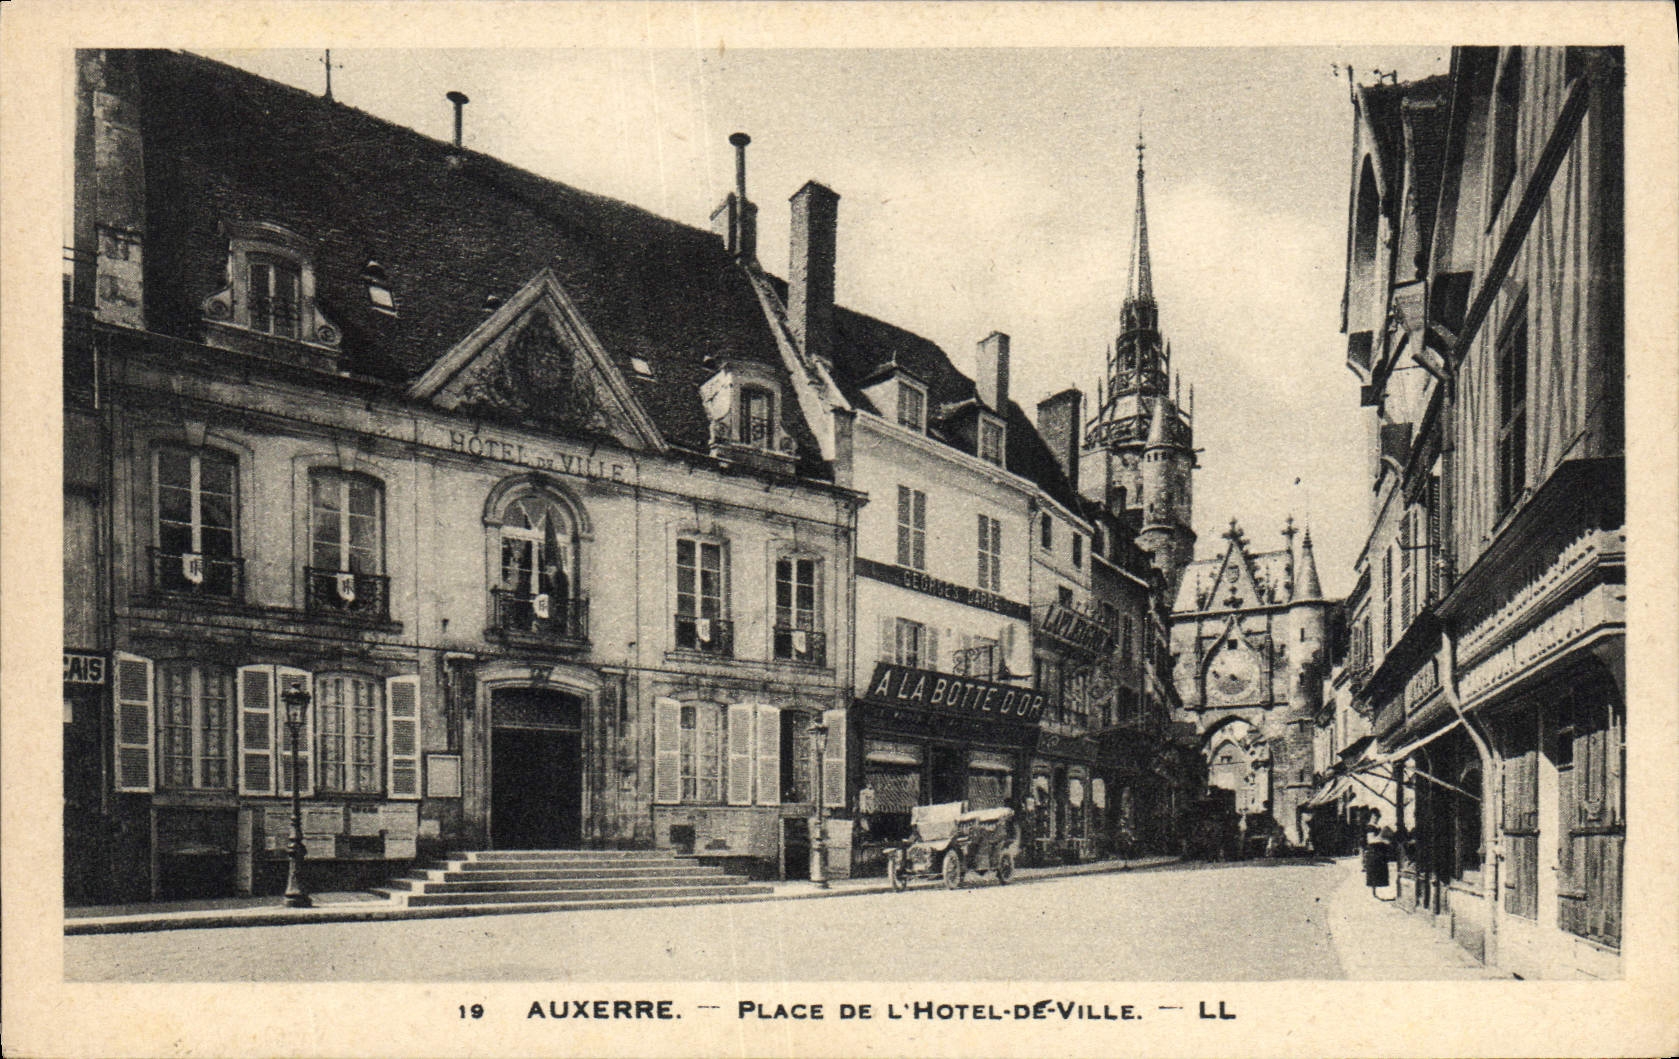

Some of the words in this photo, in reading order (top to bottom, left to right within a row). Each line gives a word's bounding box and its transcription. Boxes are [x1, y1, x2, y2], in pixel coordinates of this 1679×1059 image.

[560, 453, 624, 483] VILLE
[874, 670, 891, 697] A
[897, 672, 926, 702] LA
[931, 678, 998, 712] BOTTE
